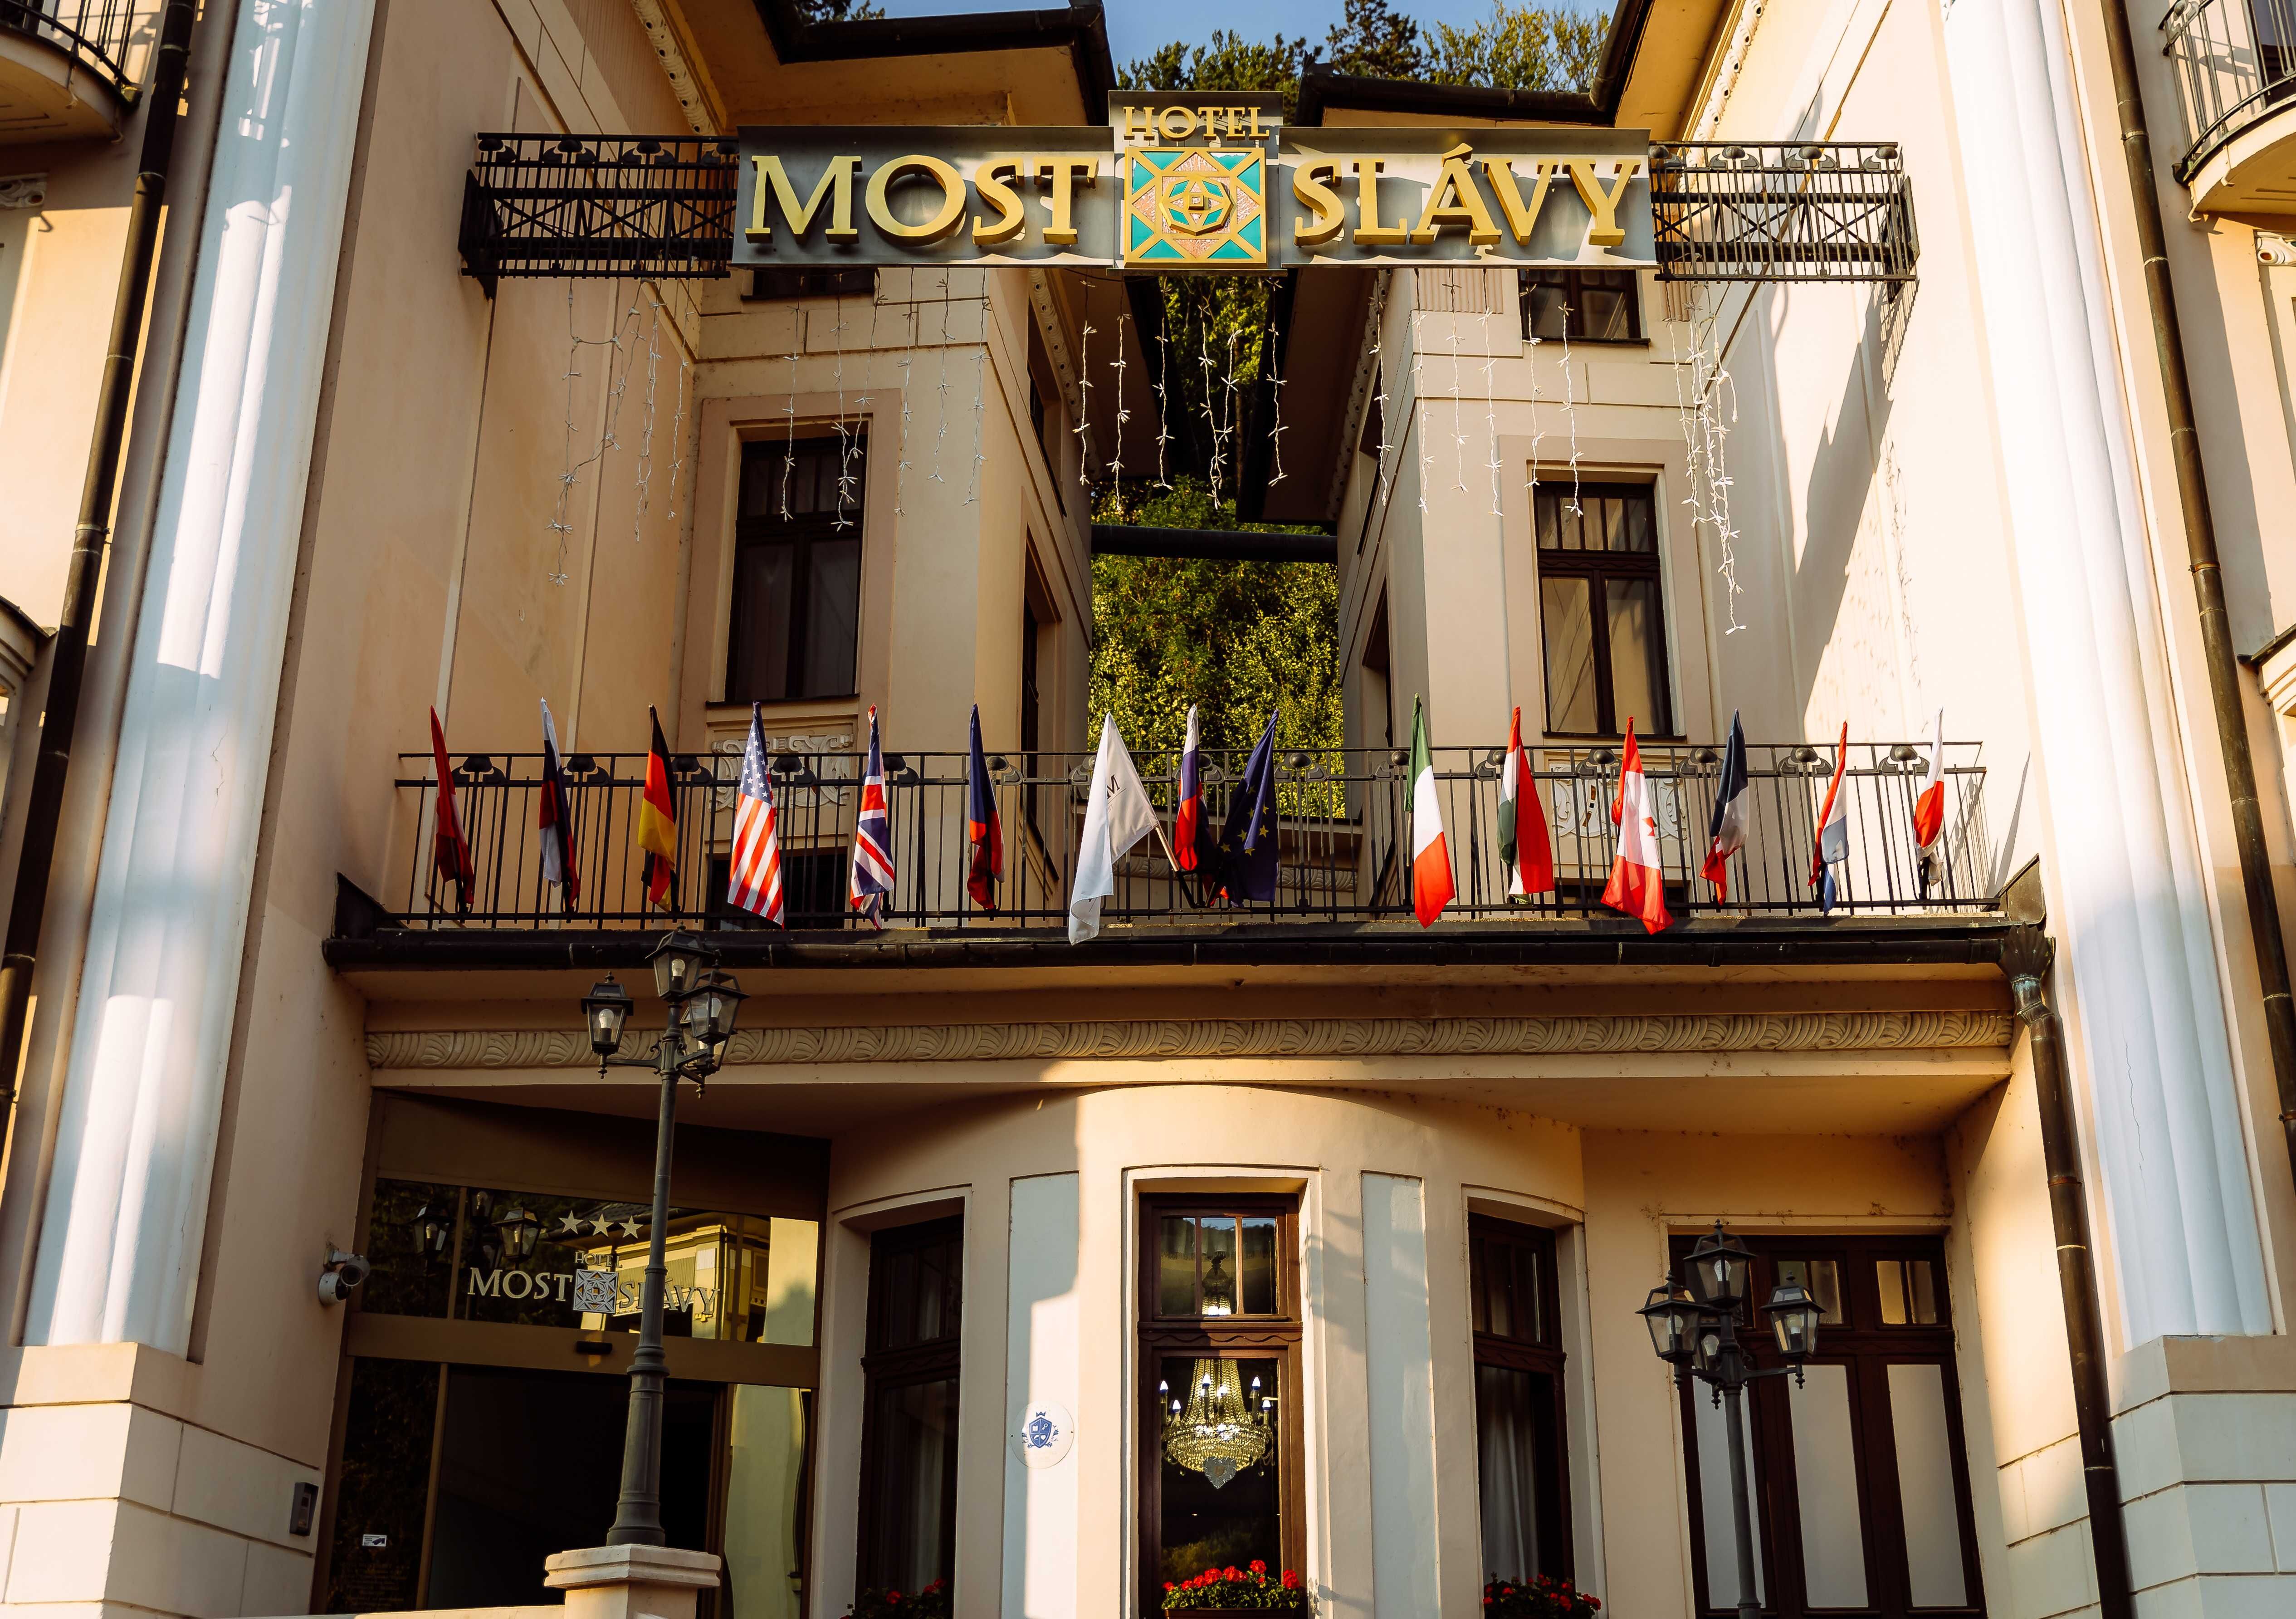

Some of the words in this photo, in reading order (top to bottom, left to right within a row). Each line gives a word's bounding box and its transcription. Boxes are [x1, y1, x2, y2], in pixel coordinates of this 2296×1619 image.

[1123, 106, 1270, 142] HOTEL
[745, 154, 1099, 246] MOST
[1293, 142, 1641, 246] SLÁVY
[575, 1250, 623, 1268] HOTEL
[468, 1267, 573, 1301] MOST
